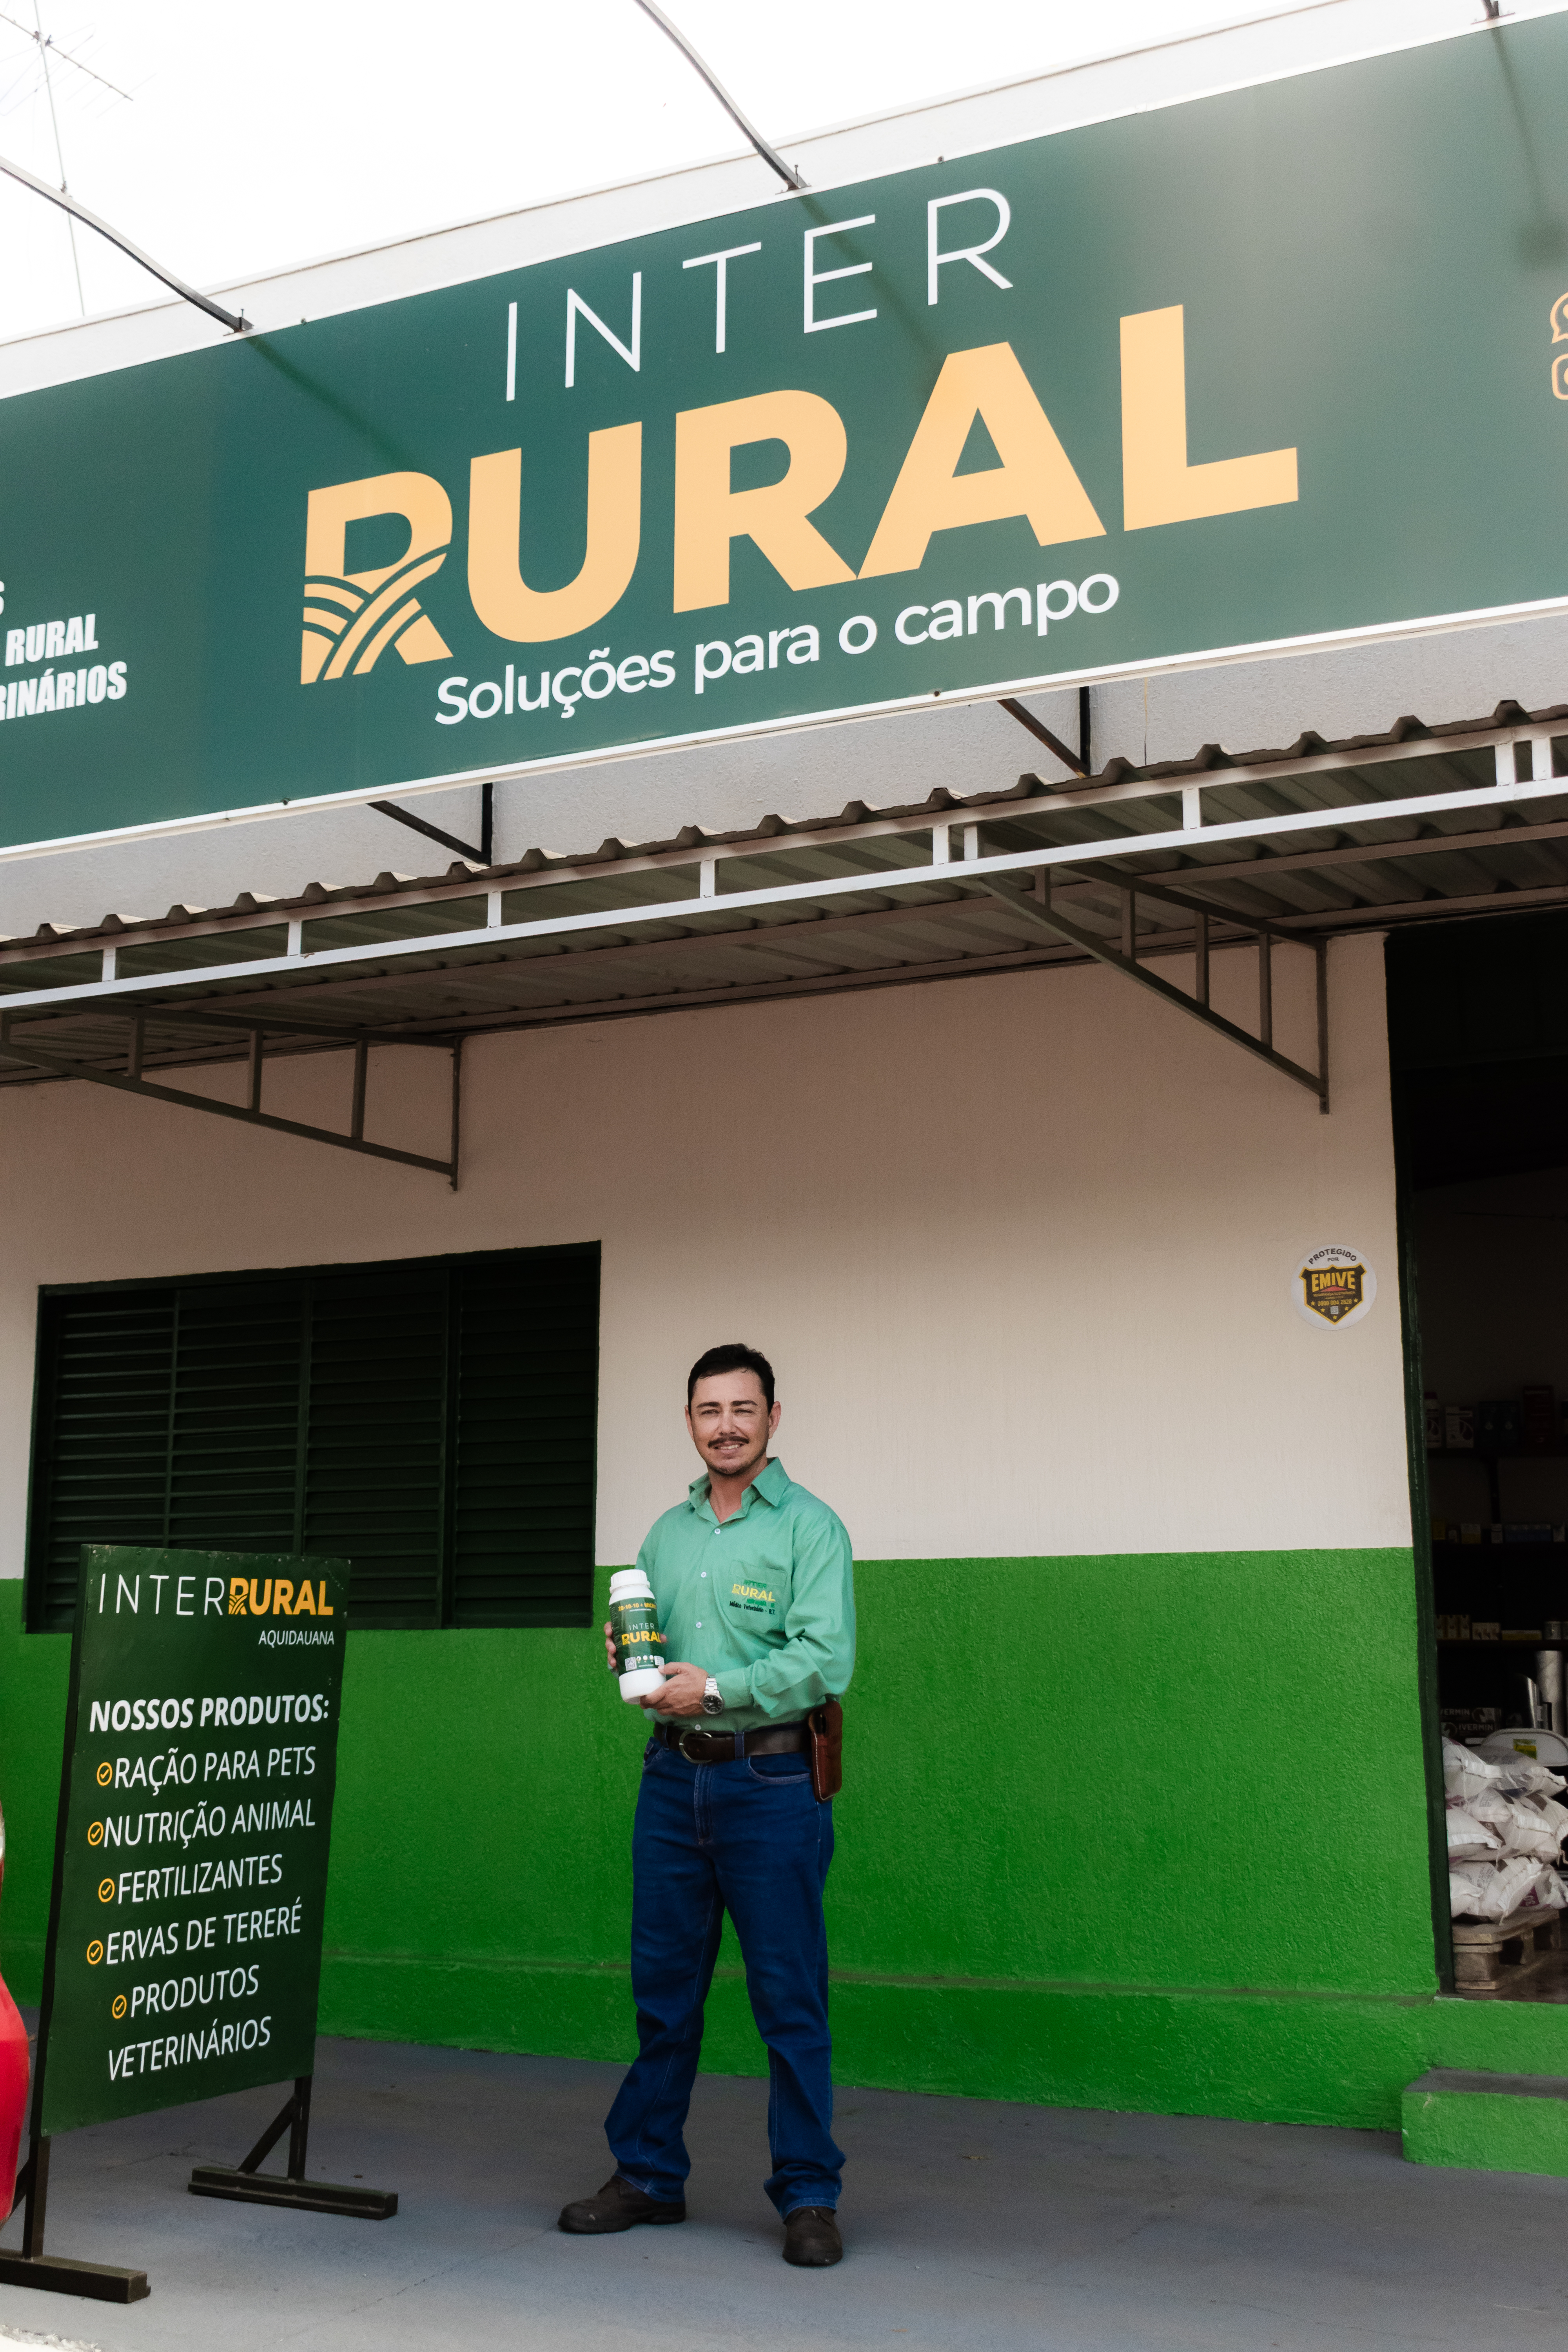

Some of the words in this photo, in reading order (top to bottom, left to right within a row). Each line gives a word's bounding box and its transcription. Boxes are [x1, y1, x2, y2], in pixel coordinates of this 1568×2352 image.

[505, 188, 1014, 401] INTER
[301, 304, 1298, 684] RURAL
[5, 613, 99, 666] RURAL
[435, 647, 675, 725] Soluções
[695, 625, 819, 694] para
[839, 615, 877, 654] o
[895, 573, 1120, 645] campo
[1308, 1248, 1357, 1265] PROTEGIDO
[1312, 1271, 1355, 1292] EMIVE
[732, 1584, 776, 1602] RURAL
[258, 1630, 334, 1648] AQUIDAUANA
[621, 1631, 661, 1645] RURAL
[629, 1622, 655, 1631] INTER
[89, 1698, 194, 1732] NOSSOS
[200, 1694, 329, 1727] PRODUTOS:
[114, 1747, 197, 1796] RAÇÃO
[203, 1750, 260, 1782] PARA
[267, 1746, 316, 1777] PETS
[104, 1800, 226, 1849] NUTRIÇÃO
[231, 1799, 315, 1834] ANIMAL
[118, 1854, 282, 1904] FERTILIZANTES
[106, 1922, 179, 1965] ERVAS
[186, 1916, 216, 1951] DE
[223, 1896, 302, 1944] TERERÉ
[131, 1964, 259, 2018] PRODUTOS
[109, 2016, 271, 2081] VETERINÁRIOS
